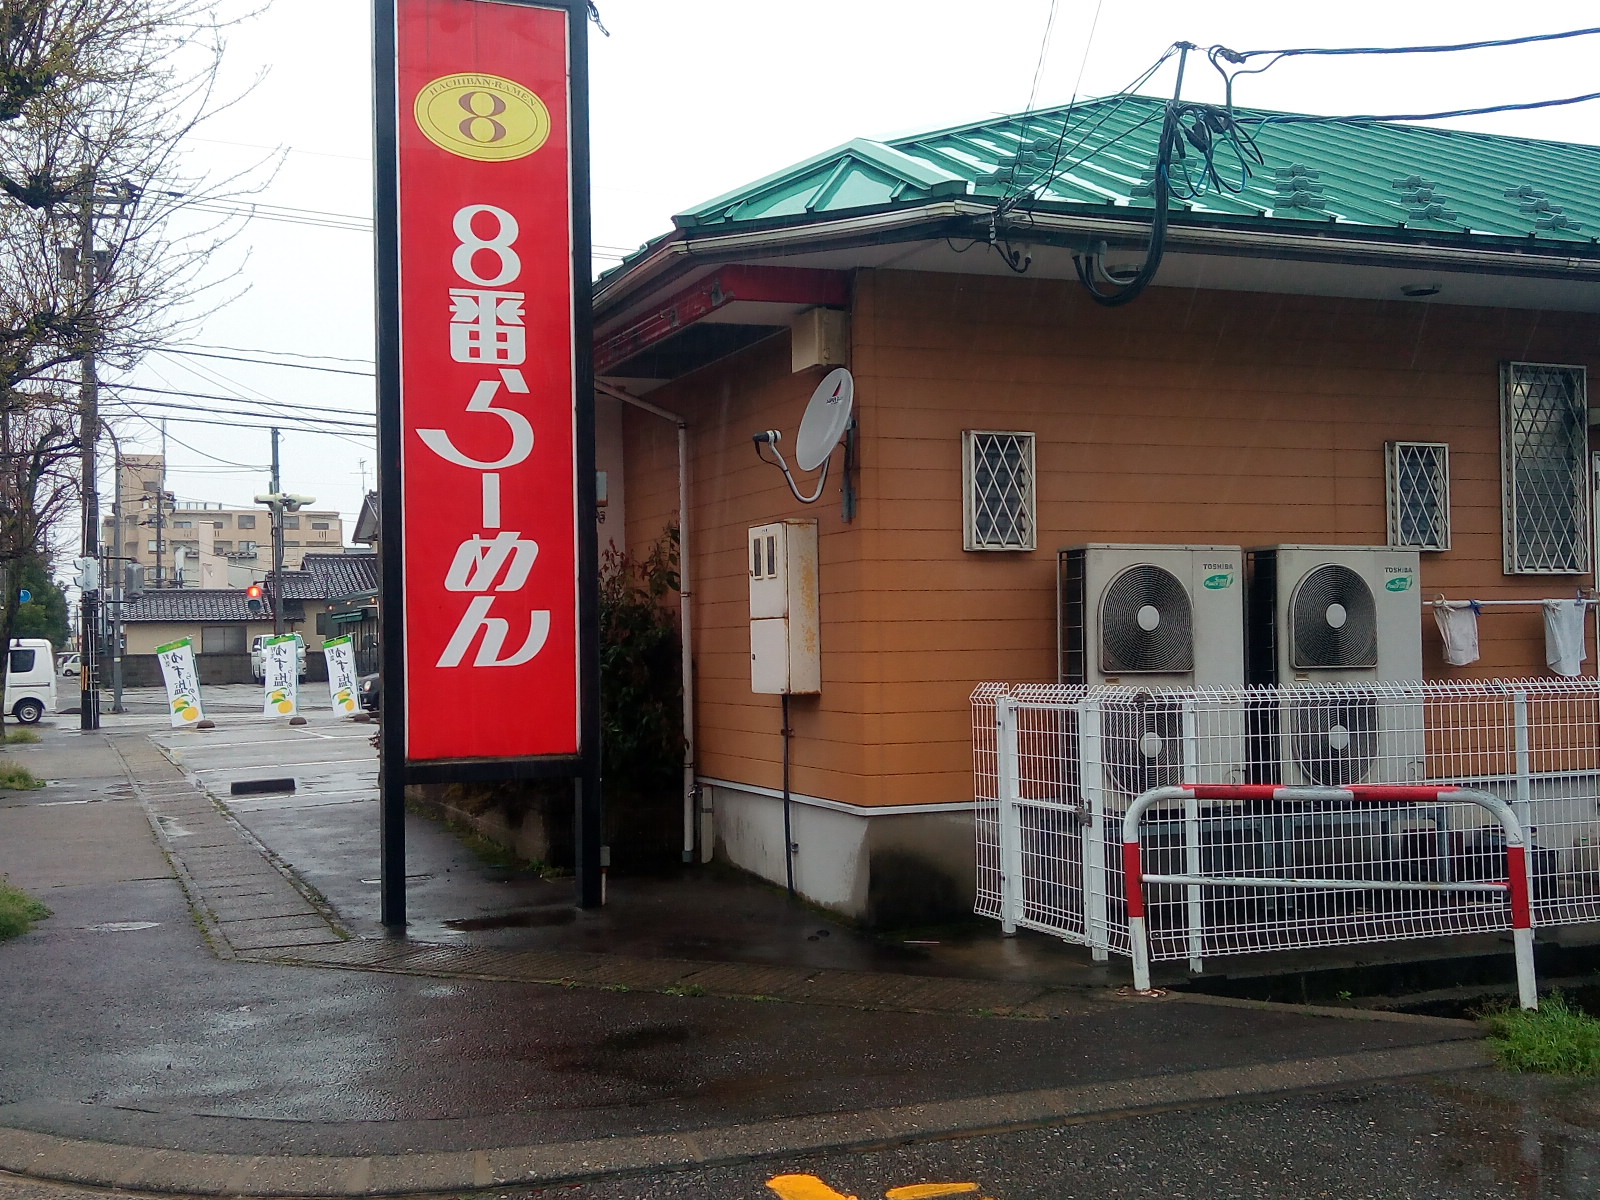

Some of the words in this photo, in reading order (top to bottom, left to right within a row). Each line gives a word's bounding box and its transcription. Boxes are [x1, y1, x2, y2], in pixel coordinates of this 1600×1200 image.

[459, 91, 507, 143] 8
[415, 204, 551, 668] 8番らーめん
